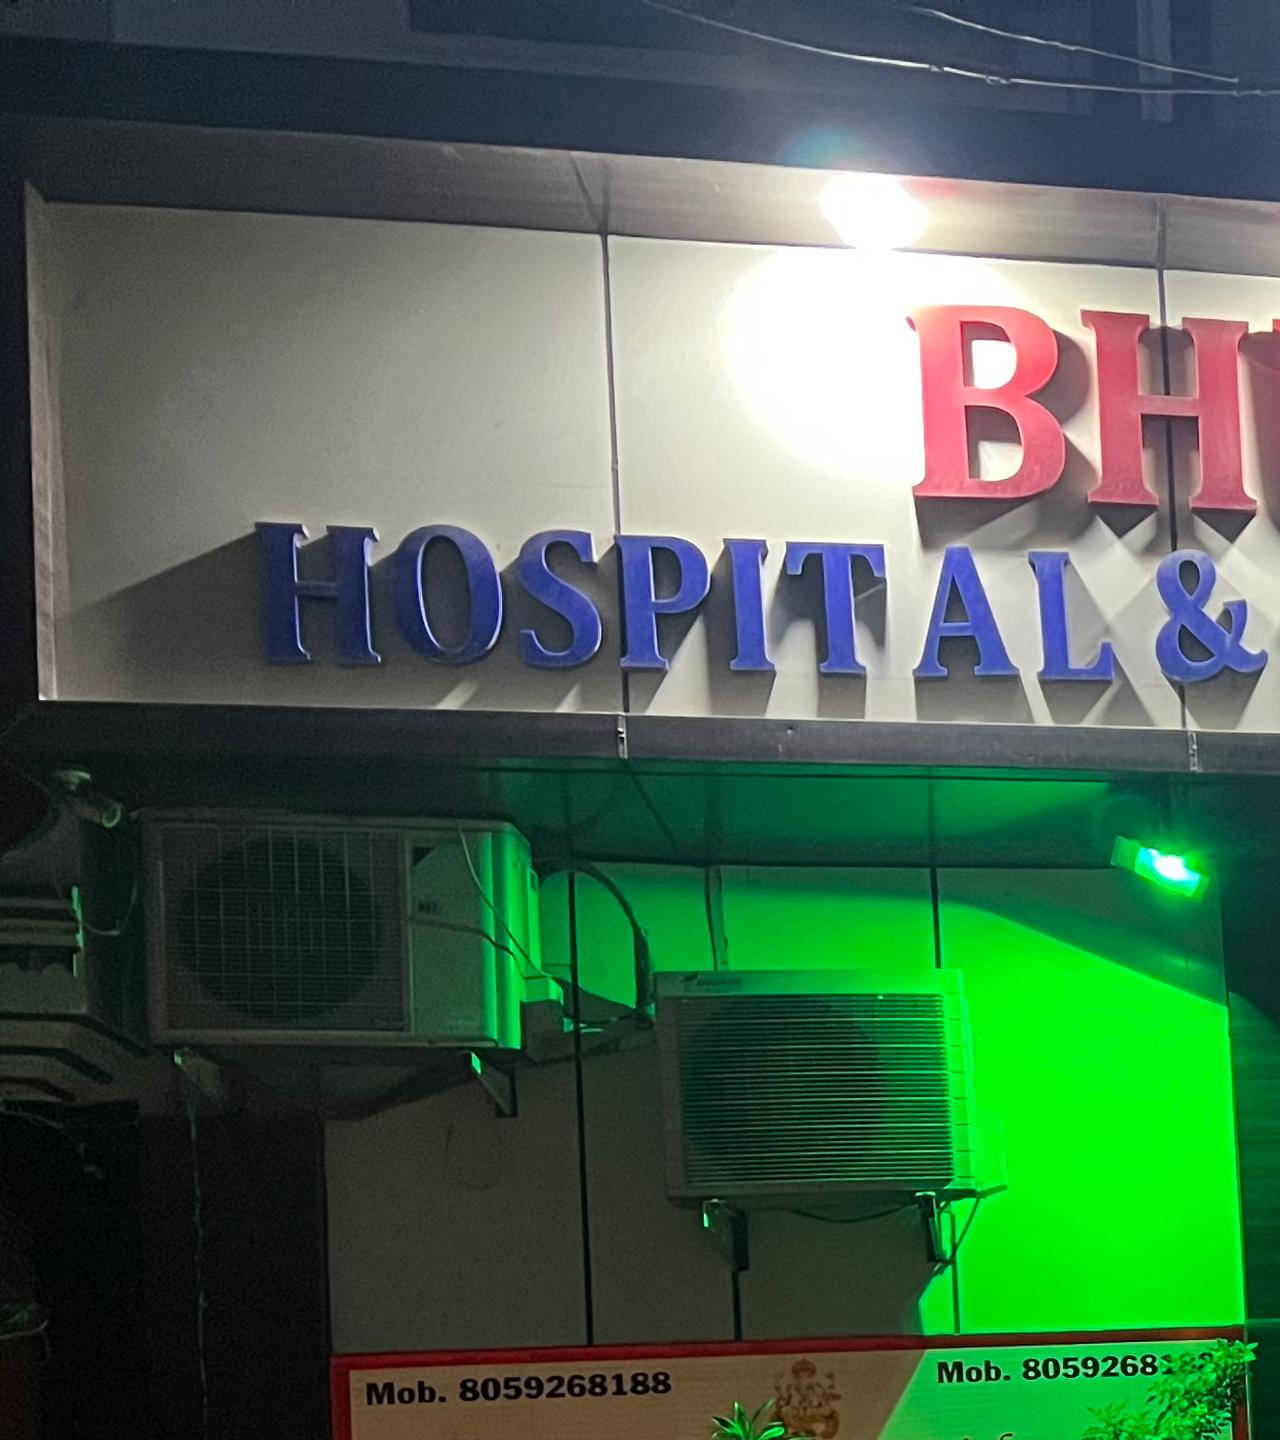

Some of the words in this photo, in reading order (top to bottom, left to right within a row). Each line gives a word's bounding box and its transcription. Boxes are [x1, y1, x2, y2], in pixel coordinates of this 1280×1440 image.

[253, 520, 1116, 682] HOSPITAL
[1155, 547, 1270, 683] &
[366, 1379, 447, 1406] Mob.
[458, 1370, 672, 1403] 8059268188
[936, 1358, 1012, 1385] Mob.
